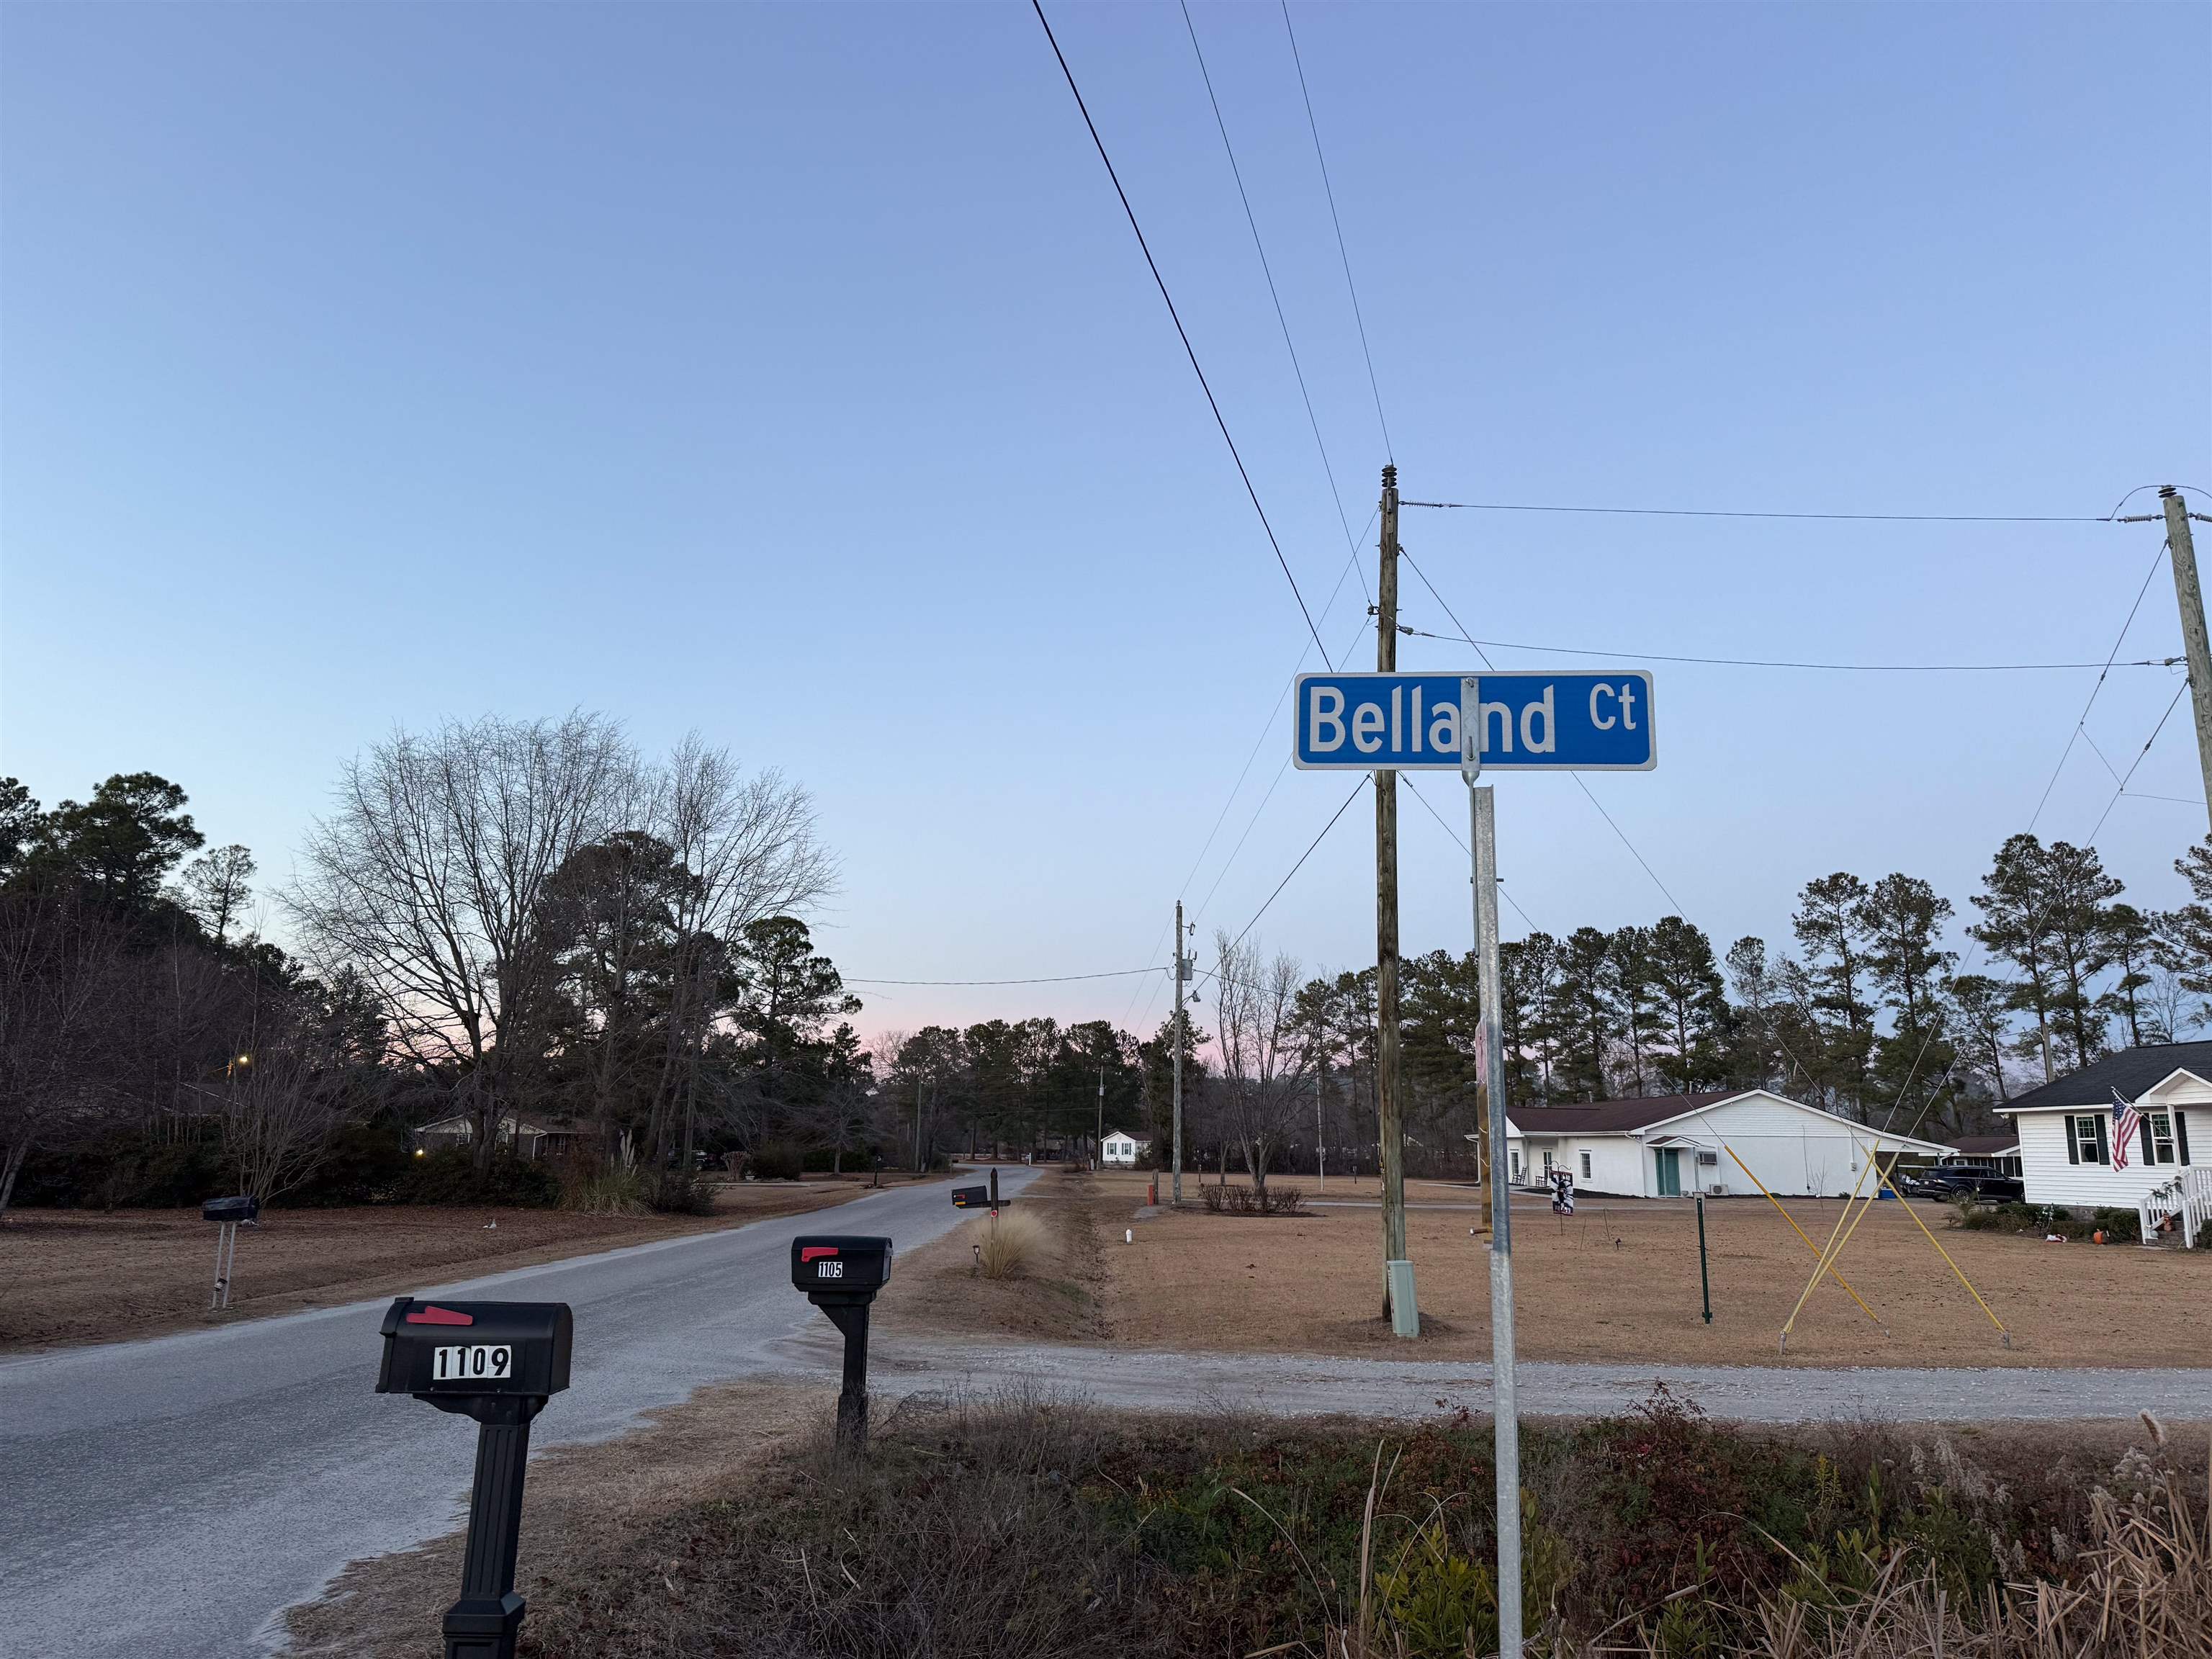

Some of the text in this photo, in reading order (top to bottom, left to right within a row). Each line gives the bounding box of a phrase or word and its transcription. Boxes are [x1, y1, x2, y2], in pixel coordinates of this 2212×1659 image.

[1308, 682, 1637, 753] Belland Ct
[819, 1262, 842, 1277] 1105
[439, 1347, 509, 1378] 1109
